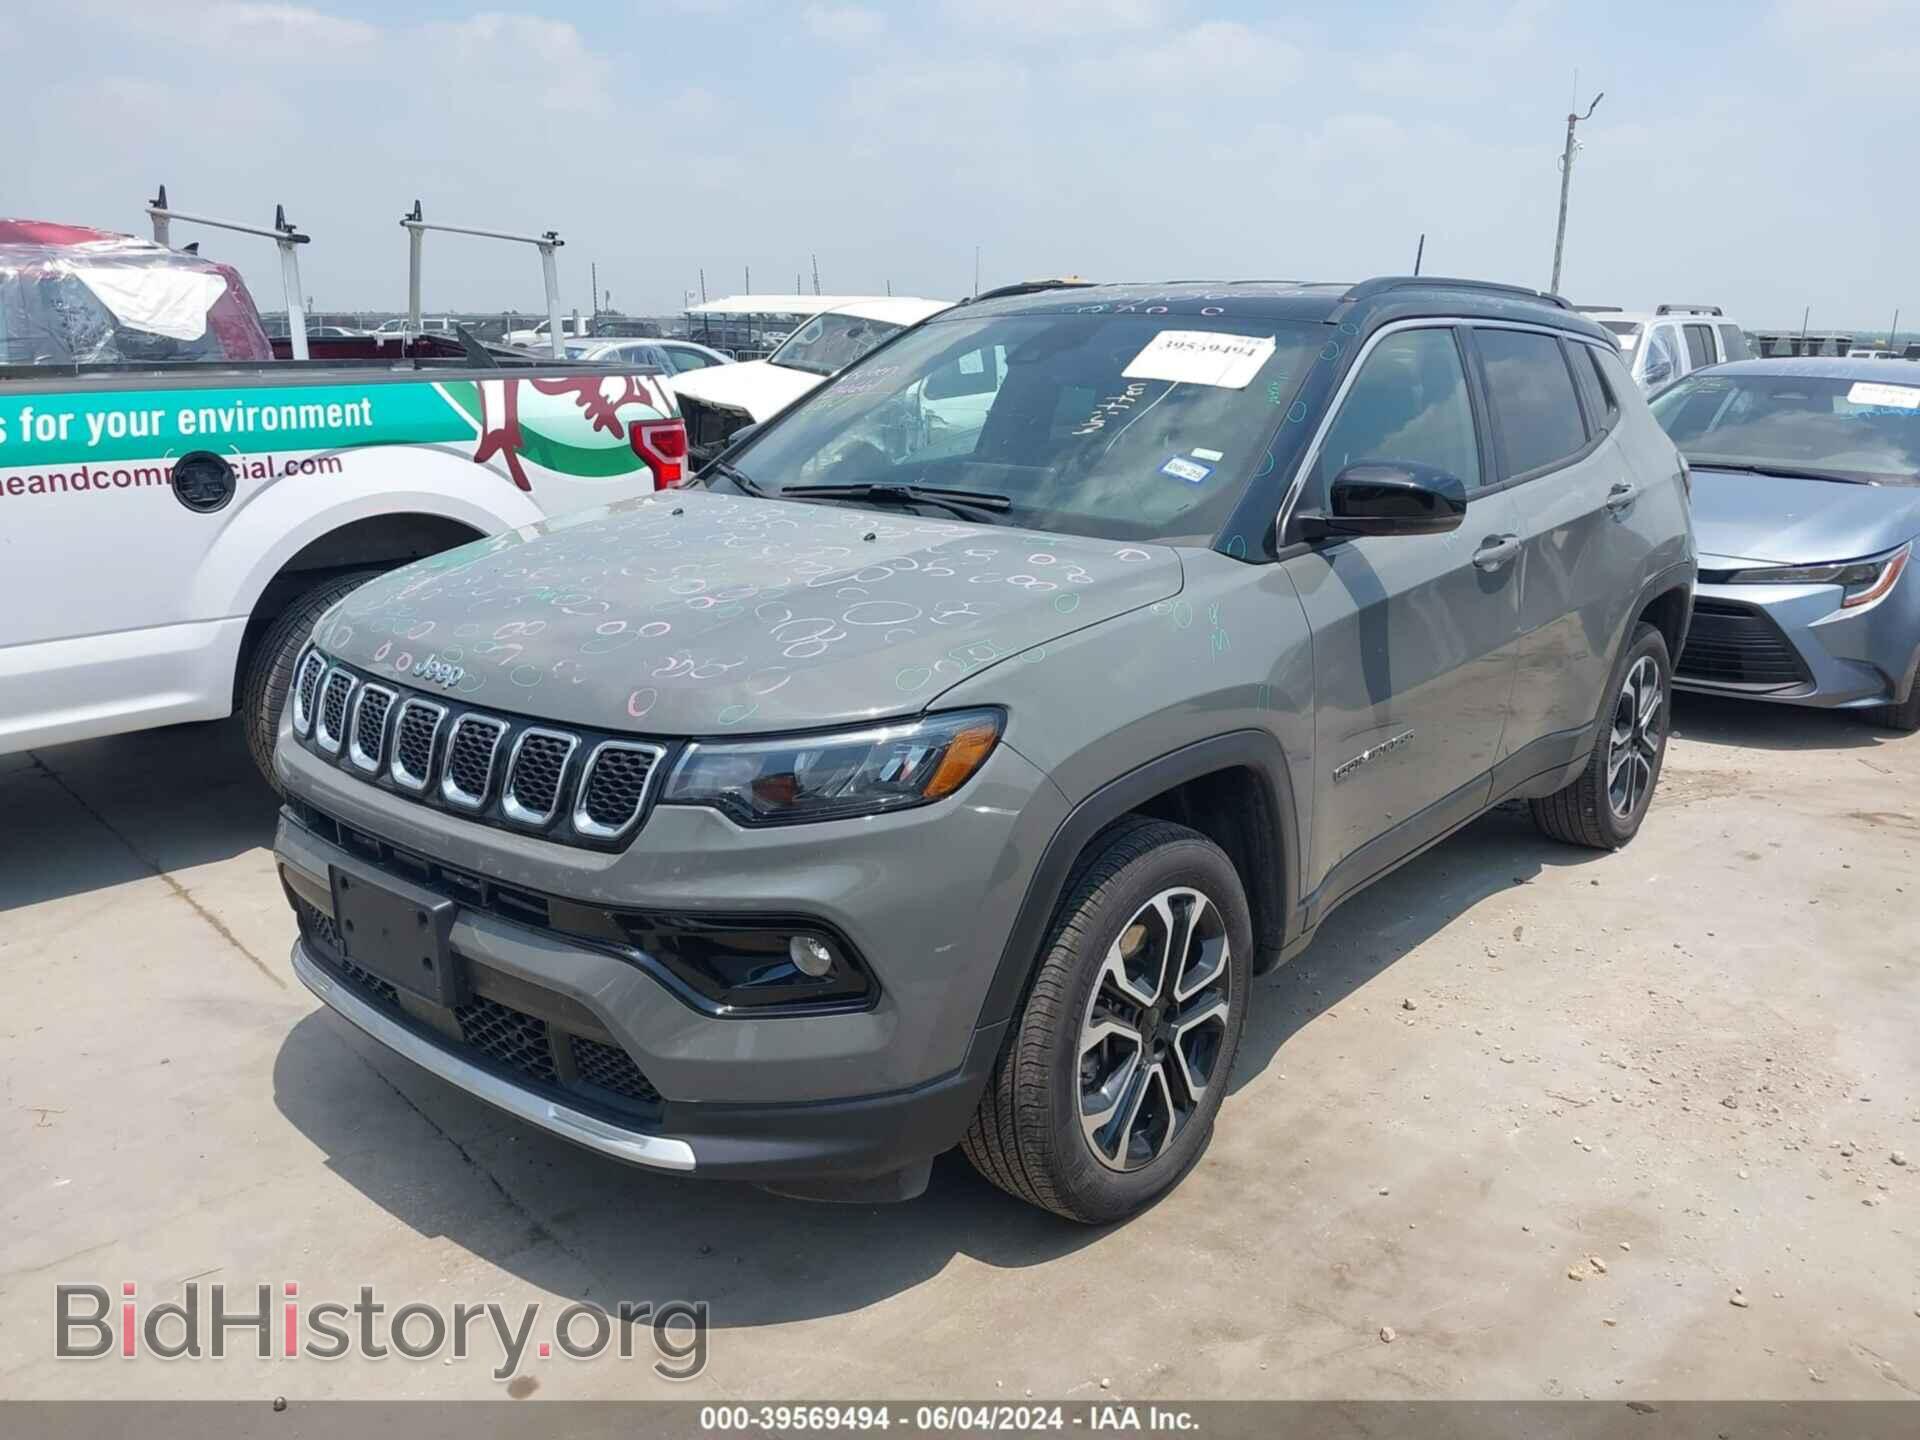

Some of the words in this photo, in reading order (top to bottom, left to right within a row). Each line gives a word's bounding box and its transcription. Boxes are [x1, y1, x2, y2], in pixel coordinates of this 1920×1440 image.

[19, 406, 75, 442] for
[86, 409, 165, 447] your
[178, 397, 373, 435] environment
[414, 653, 465, 690] Jeep
